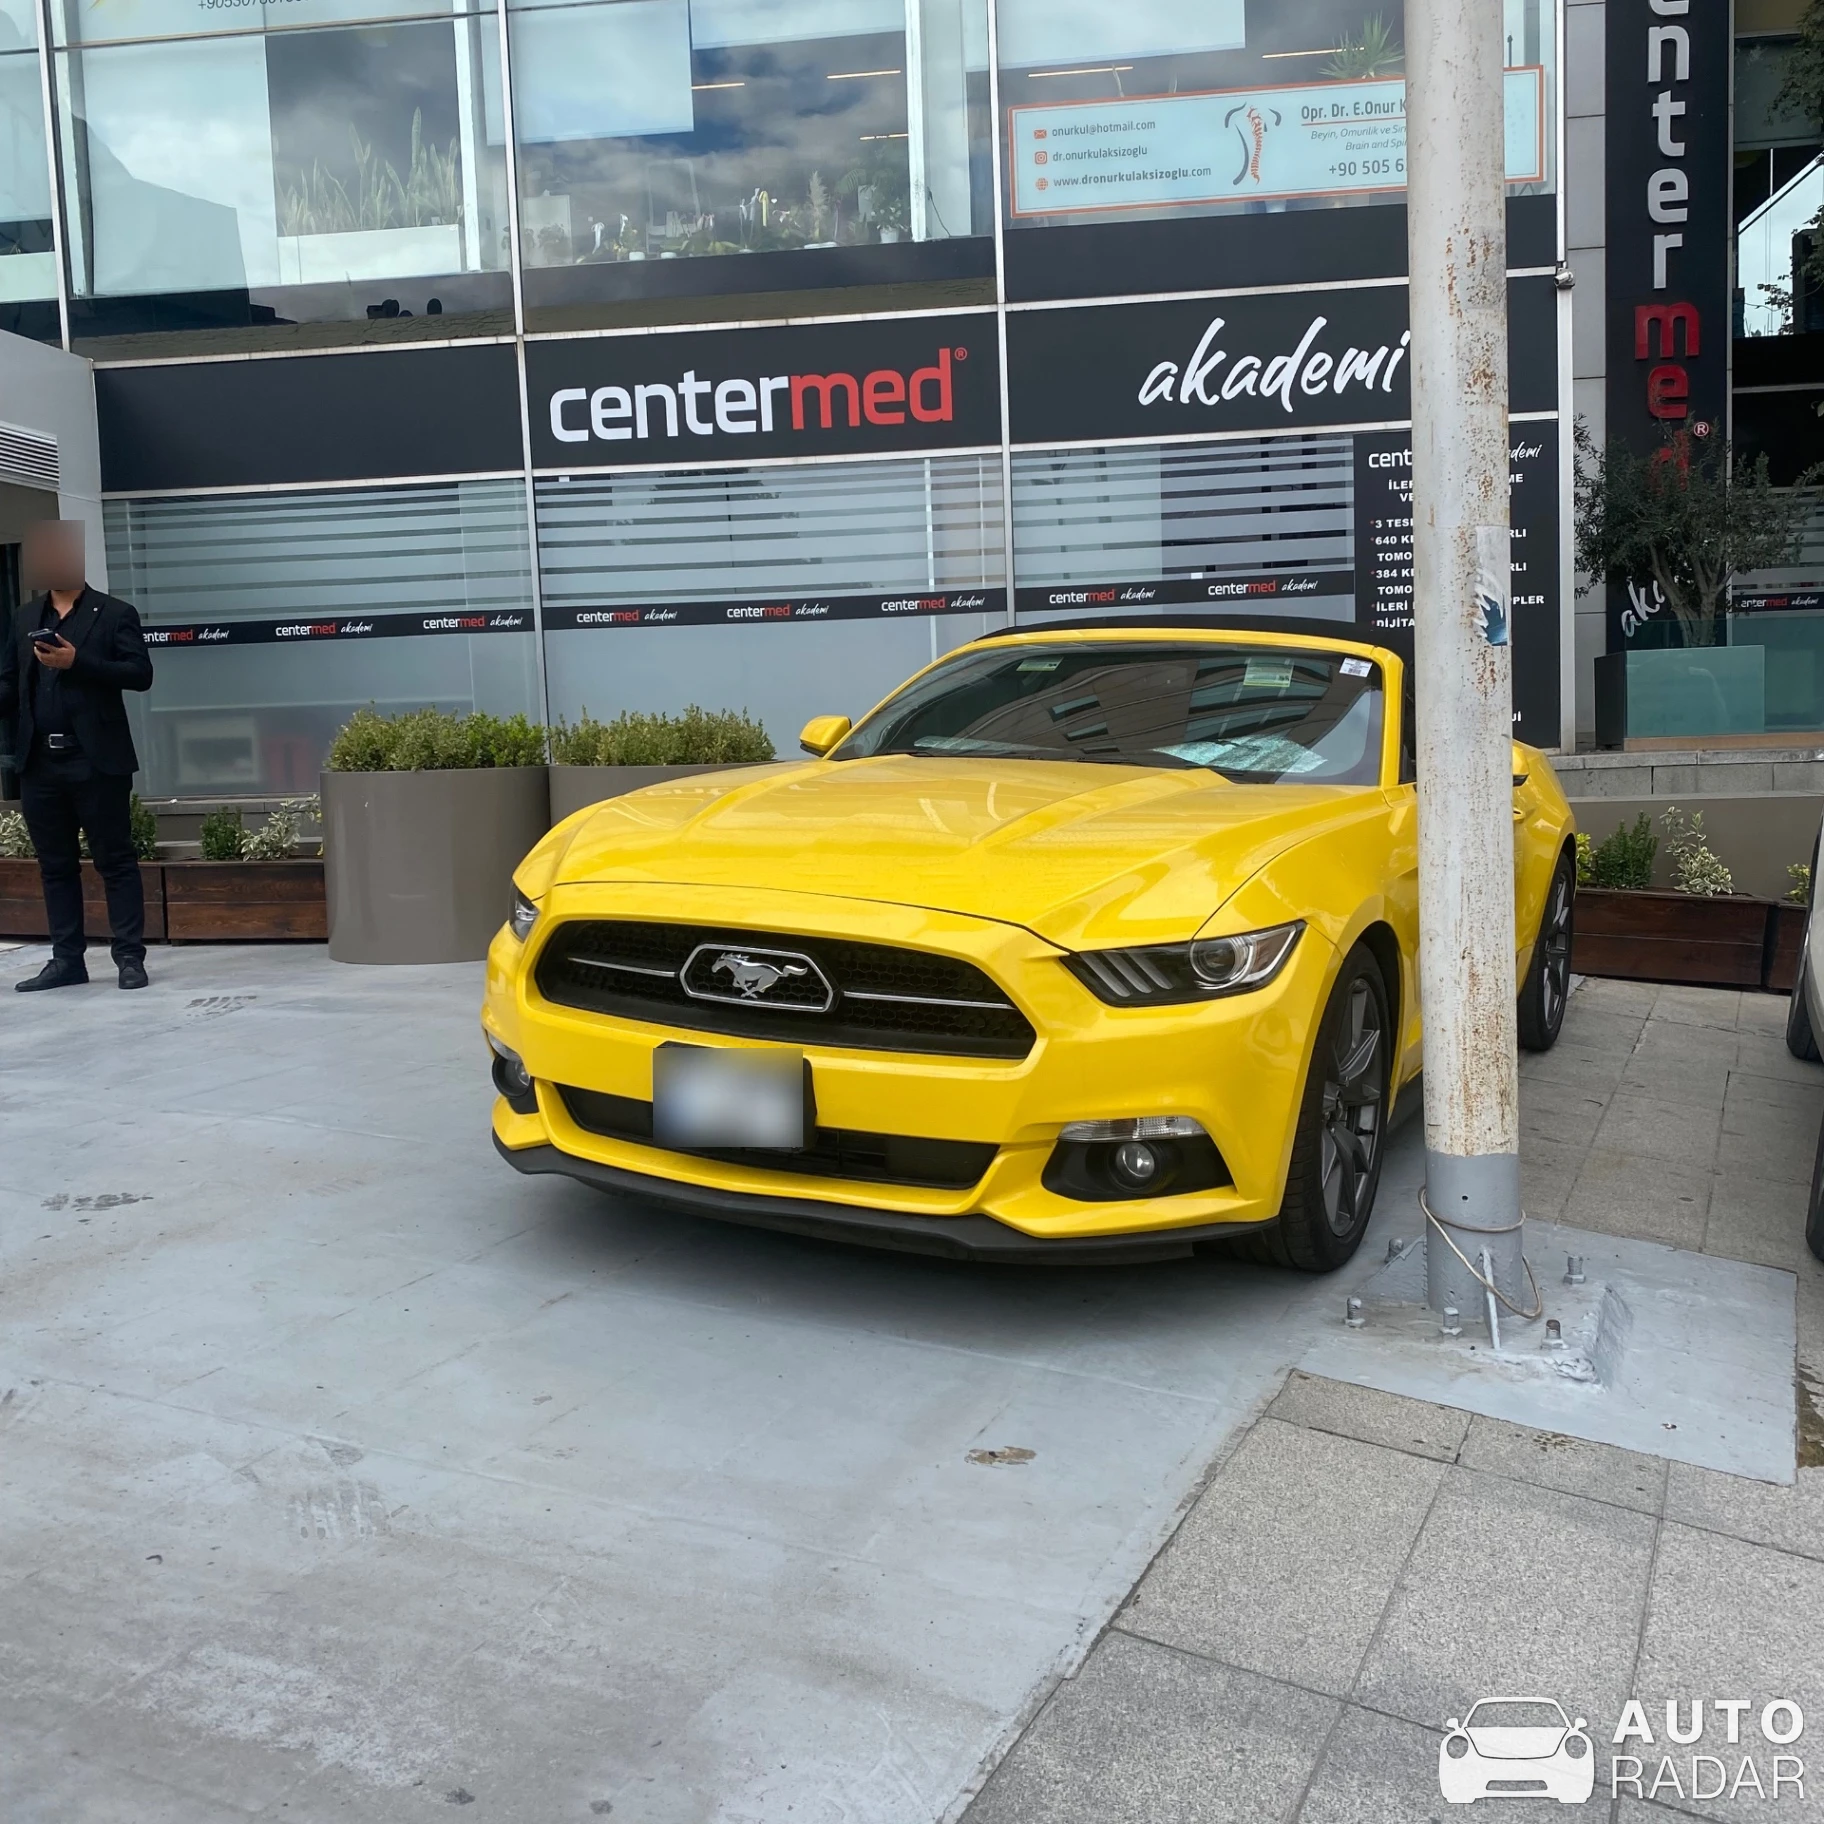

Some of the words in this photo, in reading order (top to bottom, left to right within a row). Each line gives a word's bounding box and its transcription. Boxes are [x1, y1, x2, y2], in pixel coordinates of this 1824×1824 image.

[1301, 105, 1327, 122] Opr.
[1331, 103, 1349, 118] Dr.
[1353, 100, 1396, 116] E.Onur
[1399, 98, 1406, 113] K
[1051, 120, 1156, 137] onurkul@hotmail.com
[1311, 130, 1338, 141] Beyin,
[1380, 127, 1391, 135] ve
[1345, 141, 1370, 151] Brain
[1371, 140, 1389, 149] and
[1390, 138, 1406, 150] Spi
[1052, 145, 1148, 162] dr.onurkulaksizoglu
[1329, 161, 1357, 177] +90
[1362, 159, 1390, 175] 505
[1395, 158, 1405, 173] 6
[1053, 167, 1211, 187] www.dronurkulaksizoglu.com
[1138, 316, 1411, 413] akademi
[1368, 448, 1413, 468] cent
[1375, 519, 1383, 529] 3
[1375, 535, 1397, 546] 640
[1508, 528, 1527, 538] RLI
[1376, 551, 1413, 562] TOMO
[1375, 568, 1398, 579] 384
[1509, 562, 1527, 572] RLI
[1207, 580, 1276, 596] centermed
[1281, 578, 1319, 592] akademi
[1377, 584, 1413, 595] TOMO
[881, 596, 946, 612] centermed
[950, 596, 985, 609] akademi
[1048, 588, 1116, 604] centermed
[1120, 588, 1156, 601] akademi
[1510, 595, 1545, 605] PLER
[576, 609, 640, 623] centermed
[644, 608, 678, 621] akademi
[726, 604, 792, 619] centermed
[795, 603, 830, 617] akademi
[275, 622, 337, 637] centermed
[340, 621, 373, 634] akademi
[423, 616, 486, 630] centermed
[489, 614, 523, 627] akademi
[1376, 617, 1415, 628] DİJİTA
[142, 628, 194, 643] entermed
[197, 628, 230, 641] akademi
